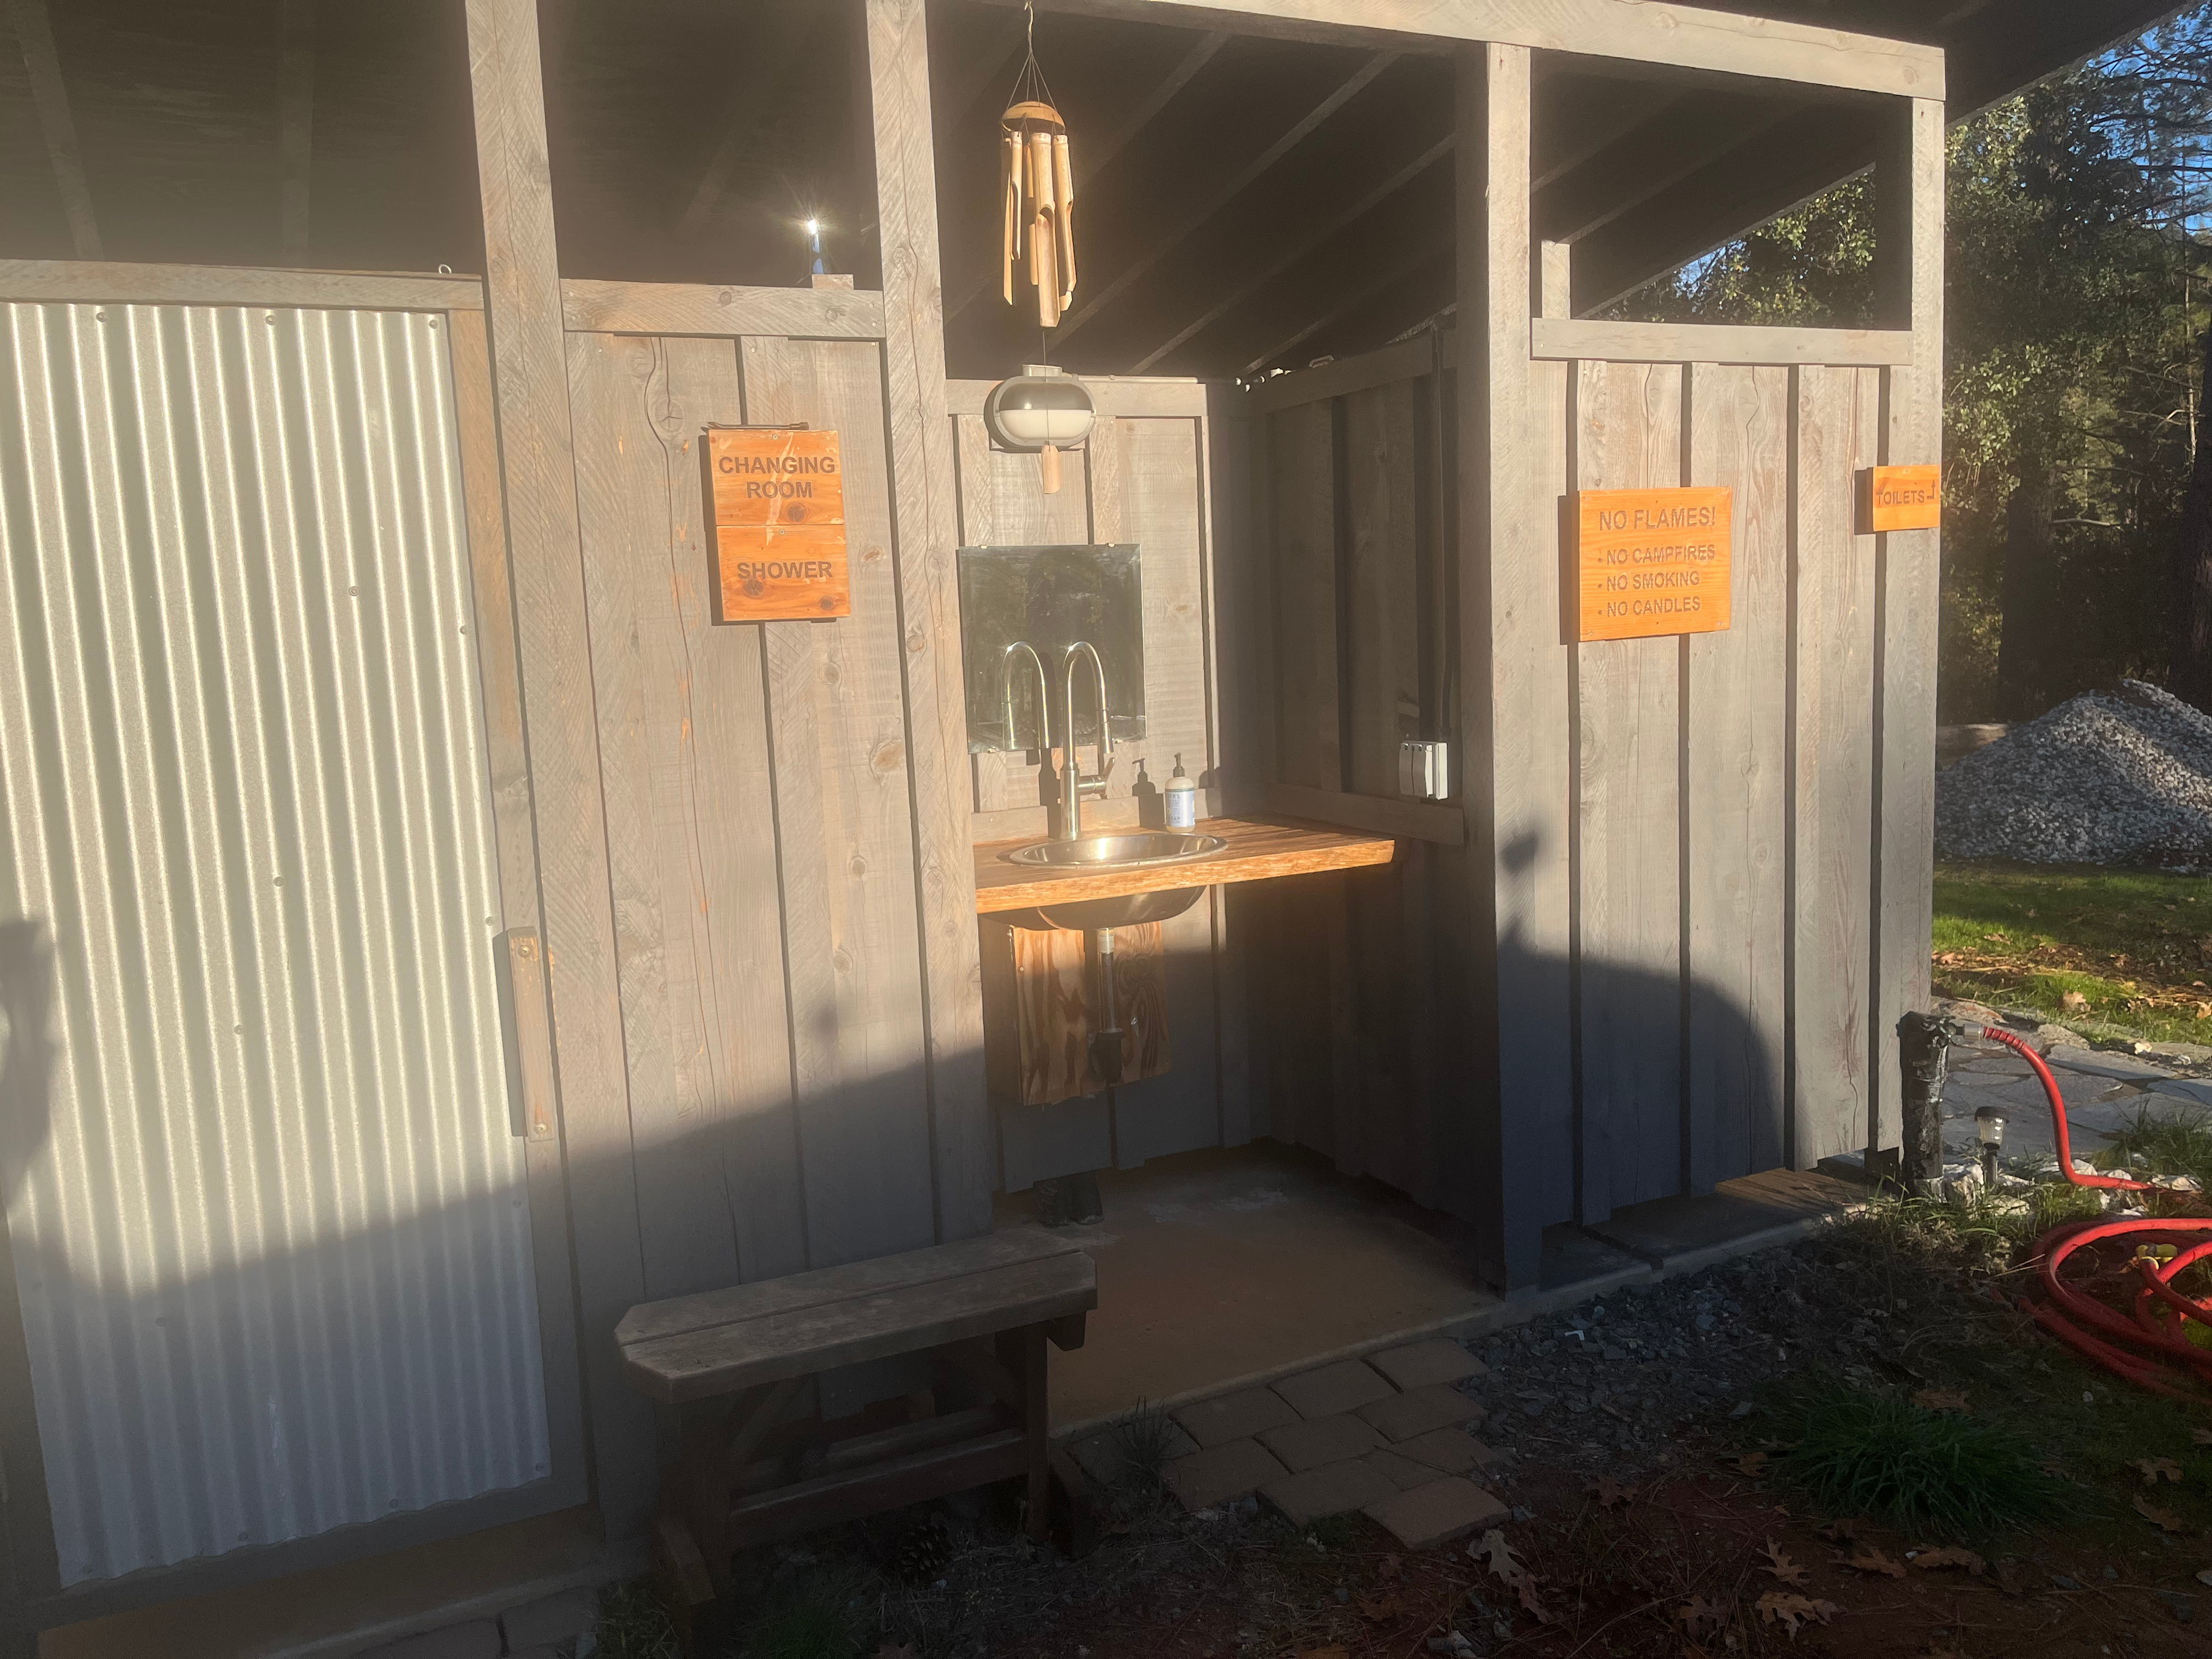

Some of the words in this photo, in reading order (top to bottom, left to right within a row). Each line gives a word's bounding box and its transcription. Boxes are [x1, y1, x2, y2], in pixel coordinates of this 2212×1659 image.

[719, 456, 835, 474] CHANGING
[747, 481, 812, 498] ROOM
[1876, 490, 1925, 505] TOILETS
[1600, 510, 1628, 531] NO
[1634, 506, 1715, 529] FLAMES!
[1607, 549, 1628, 565] NO
[1633, 544, 1715, 563] CAMPFIRES
[737, 561, 834, 579] SHOWER
[1607, 575, 1628, 592] NO
[1633, 571, 1700, 590] SMOKING
[1607, 601, 1628, 617] NO
[1633, 596, 1700, 615] CANDLES
